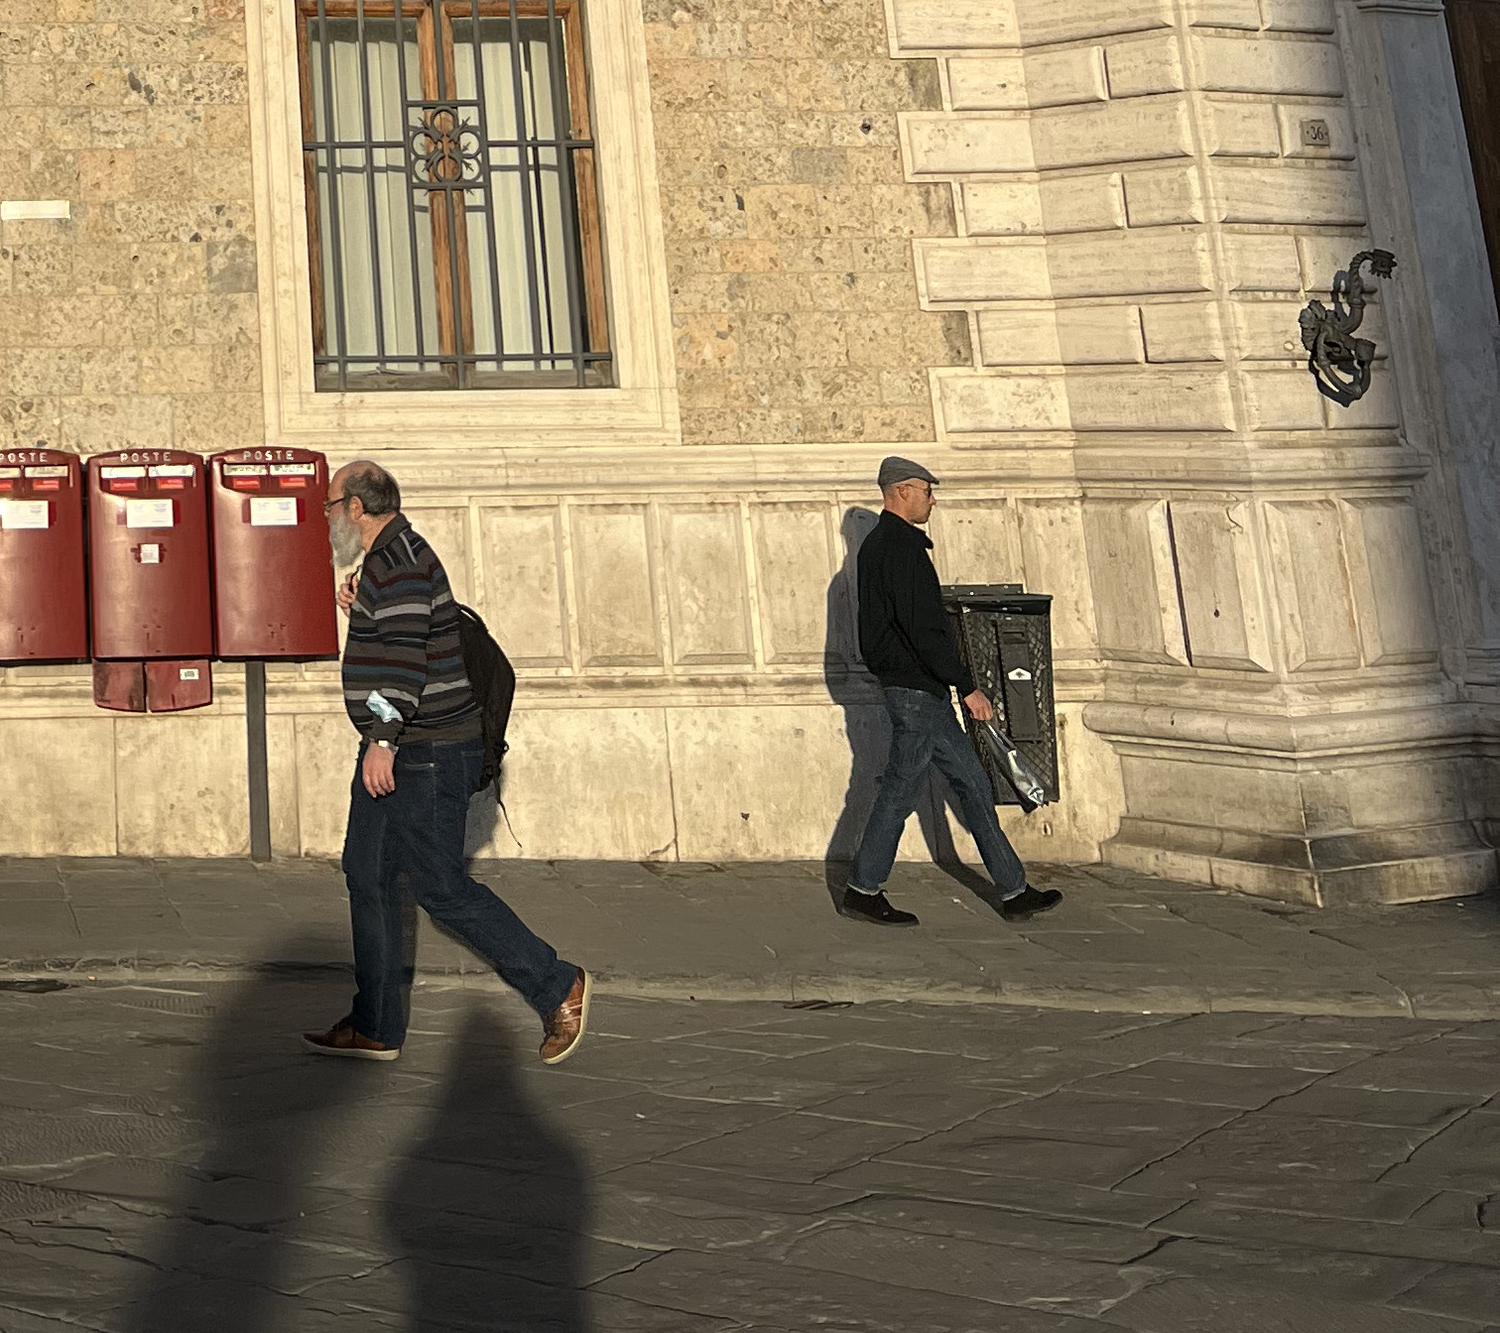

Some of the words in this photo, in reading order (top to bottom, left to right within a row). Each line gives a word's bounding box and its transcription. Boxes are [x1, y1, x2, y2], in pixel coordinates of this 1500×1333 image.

[1310, 125, 1324, 141] 36
[120, 451, 172, 463] POSTE
[243, 450, 295, 461] POSTE
